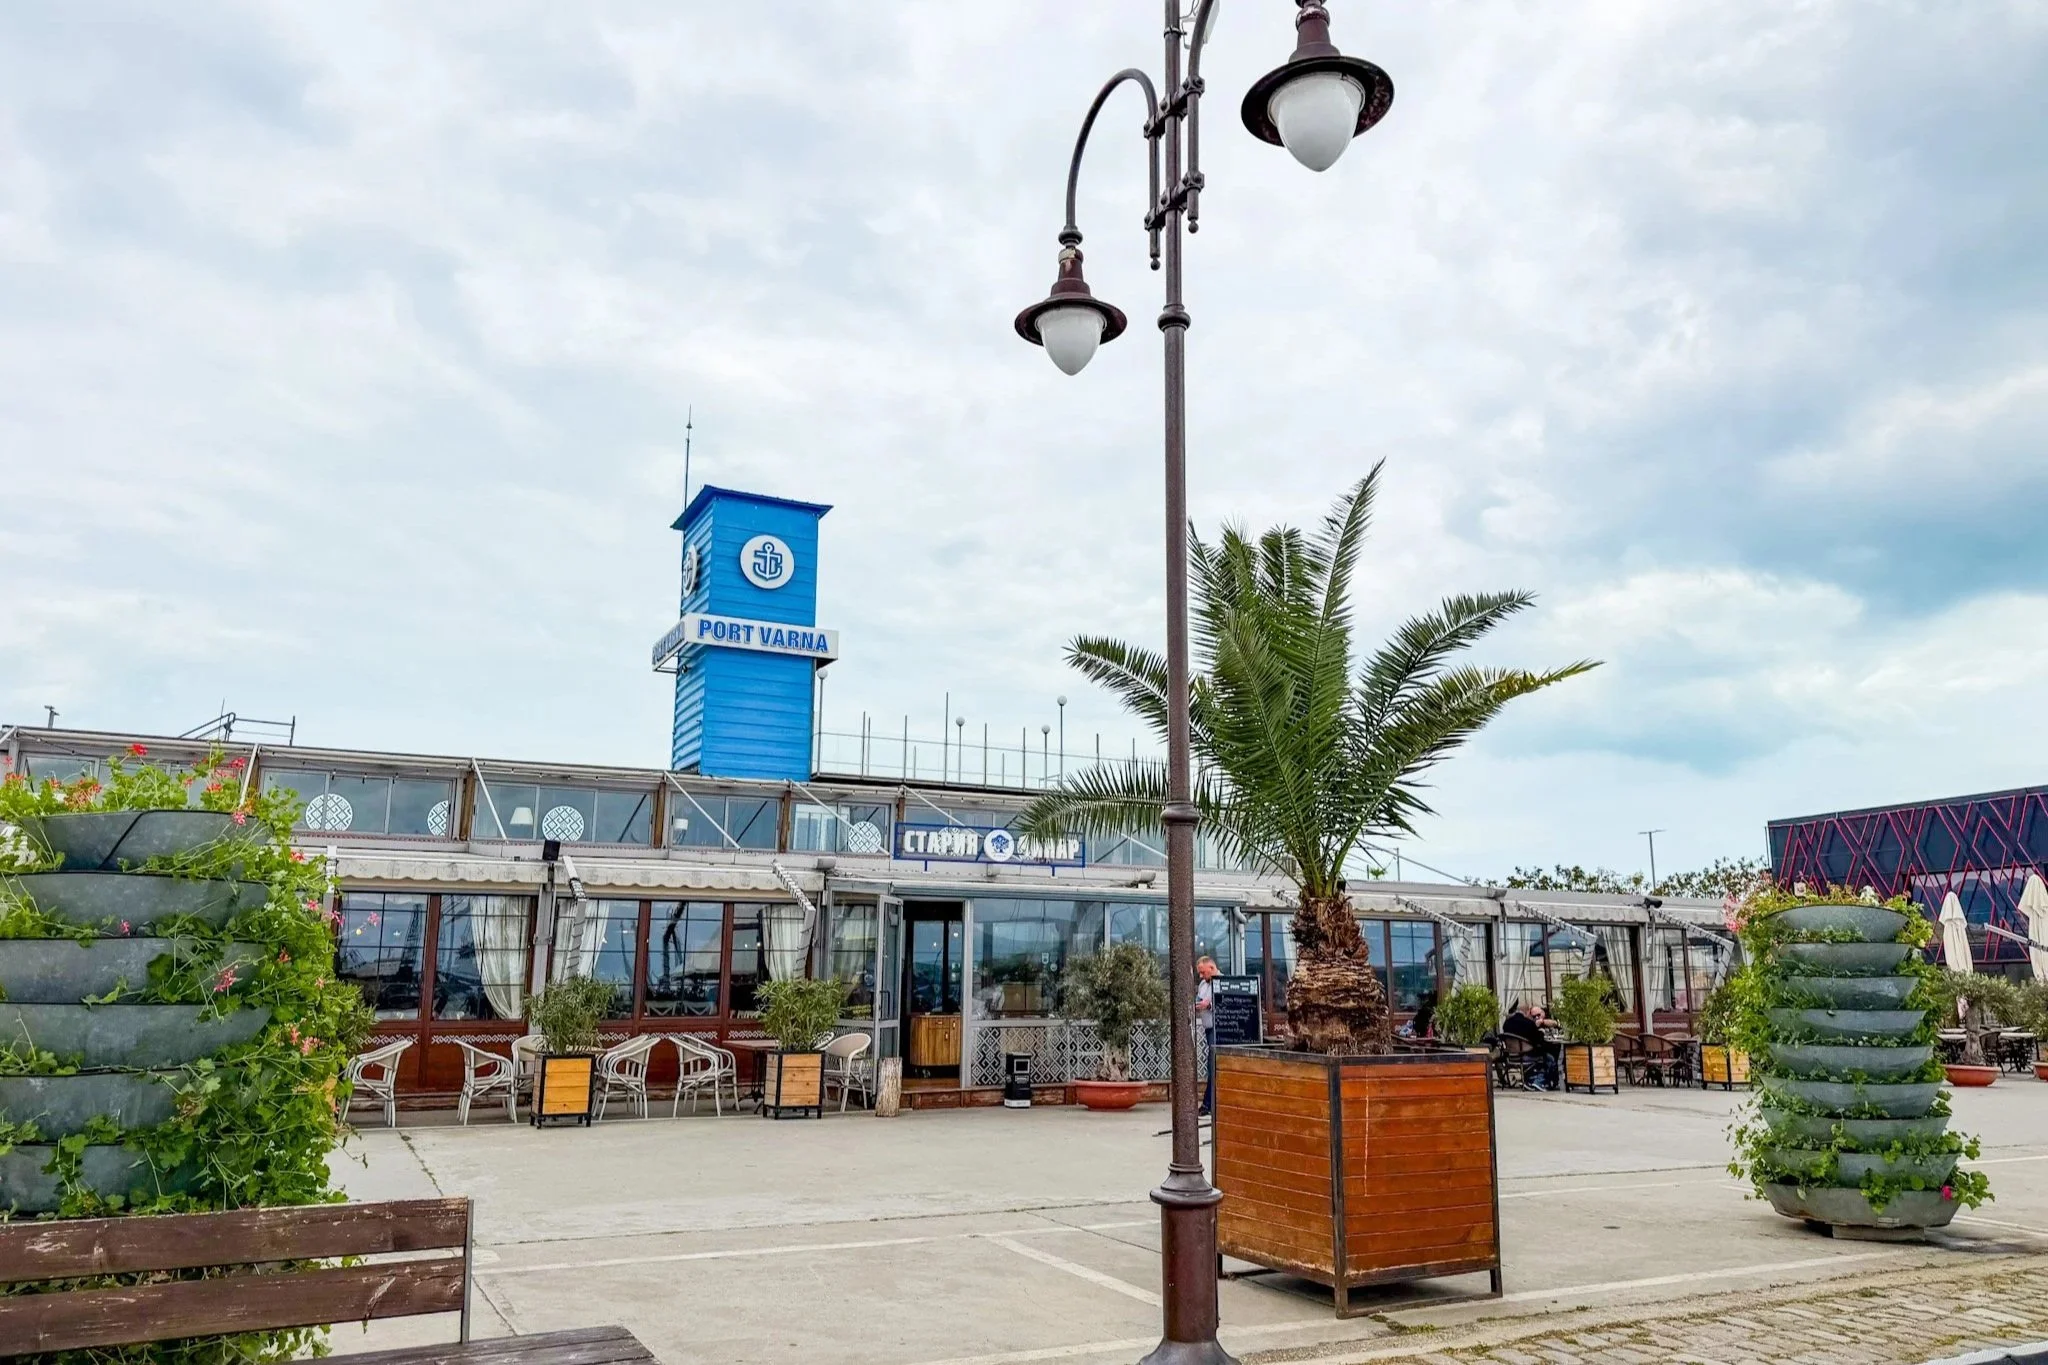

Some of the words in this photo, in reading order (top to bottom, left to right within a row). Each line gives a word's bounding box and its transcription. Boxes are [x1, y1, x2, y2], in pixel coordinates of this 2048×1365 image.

[699, 619, 755, 643] PORT
[759, 626, 828, 652] VARNA
[904, 830, 978, 855] СТАРИЯ
